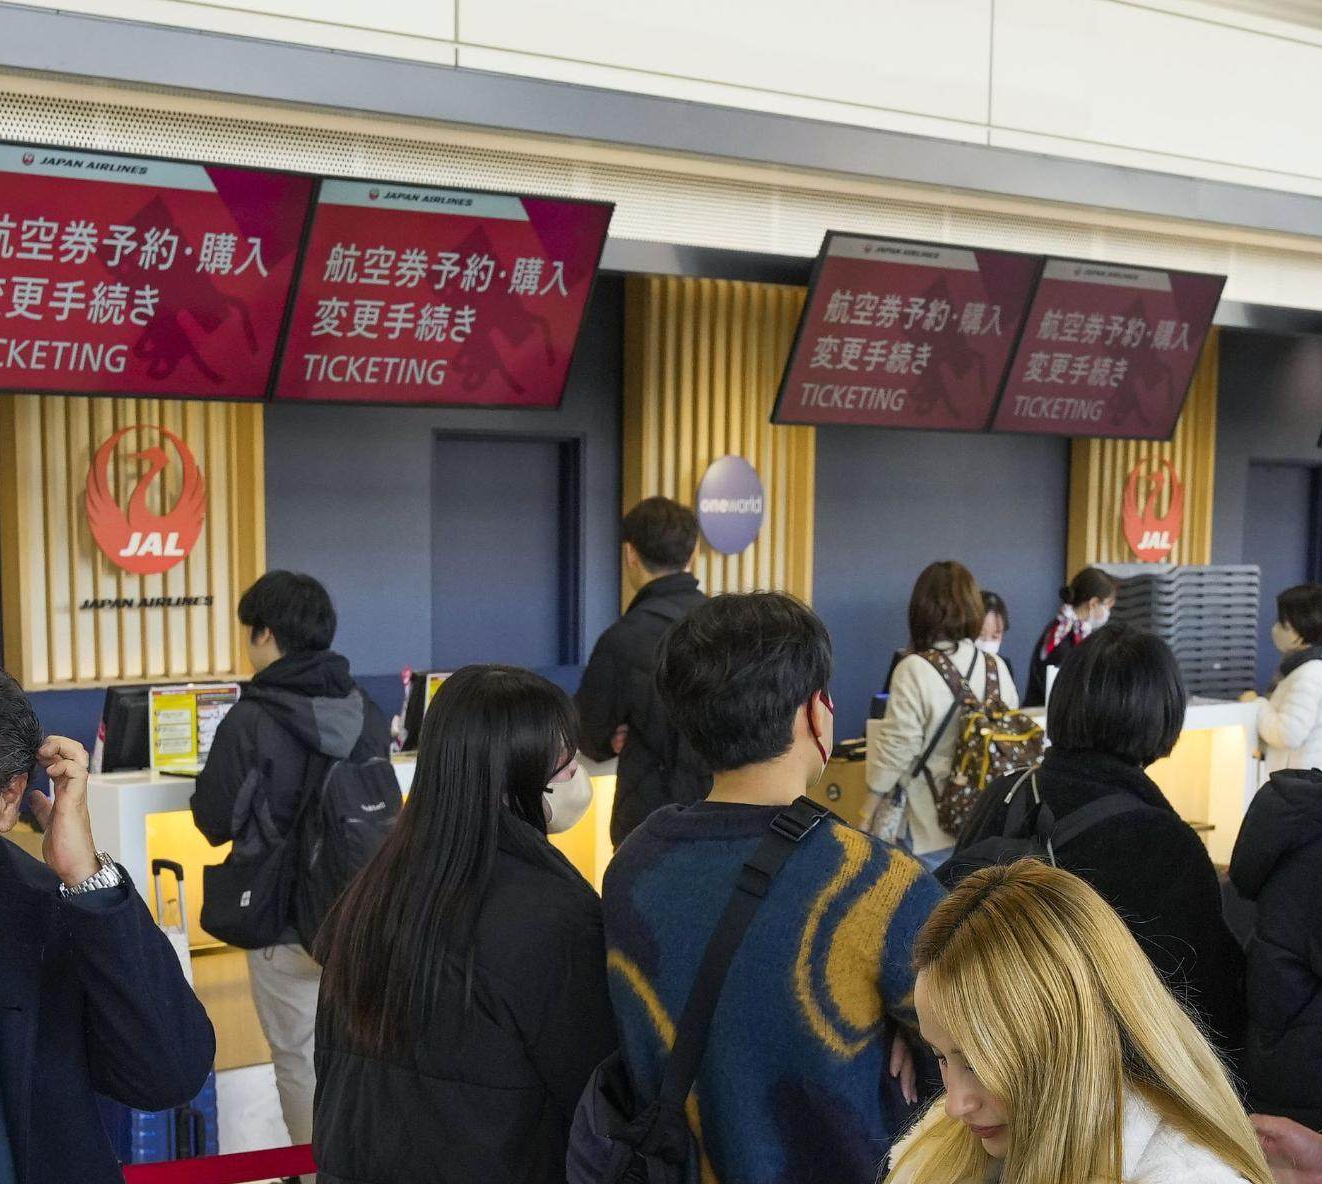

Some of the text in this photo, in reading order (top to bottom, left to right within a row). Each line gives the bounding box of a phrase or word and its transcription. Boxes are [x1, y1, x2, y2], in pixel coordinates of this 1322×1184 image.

[39, 157, 149, 175] JAPAN AIRLINES
[383, 191, 473, 207] JAPAN AIRLINES
[323, 242, 569, 298] 航空券予約・購入
[310, 297, 477, 343] 変更手続き
[809, 335, 933, 375] 変更手続き
[303, 354, 448, 386] TICKETING
[1022, 352, 1129, 388] 変更手続き
[801, 383, 908, 412] TICKETING
[1013, 395, 1106, 421] TICKETING
[119, 531, 185, 557] JAL
[1137, 530, 1172, 551] JAL
[80, 596, 214, 610] JAPAN AIRLINES
